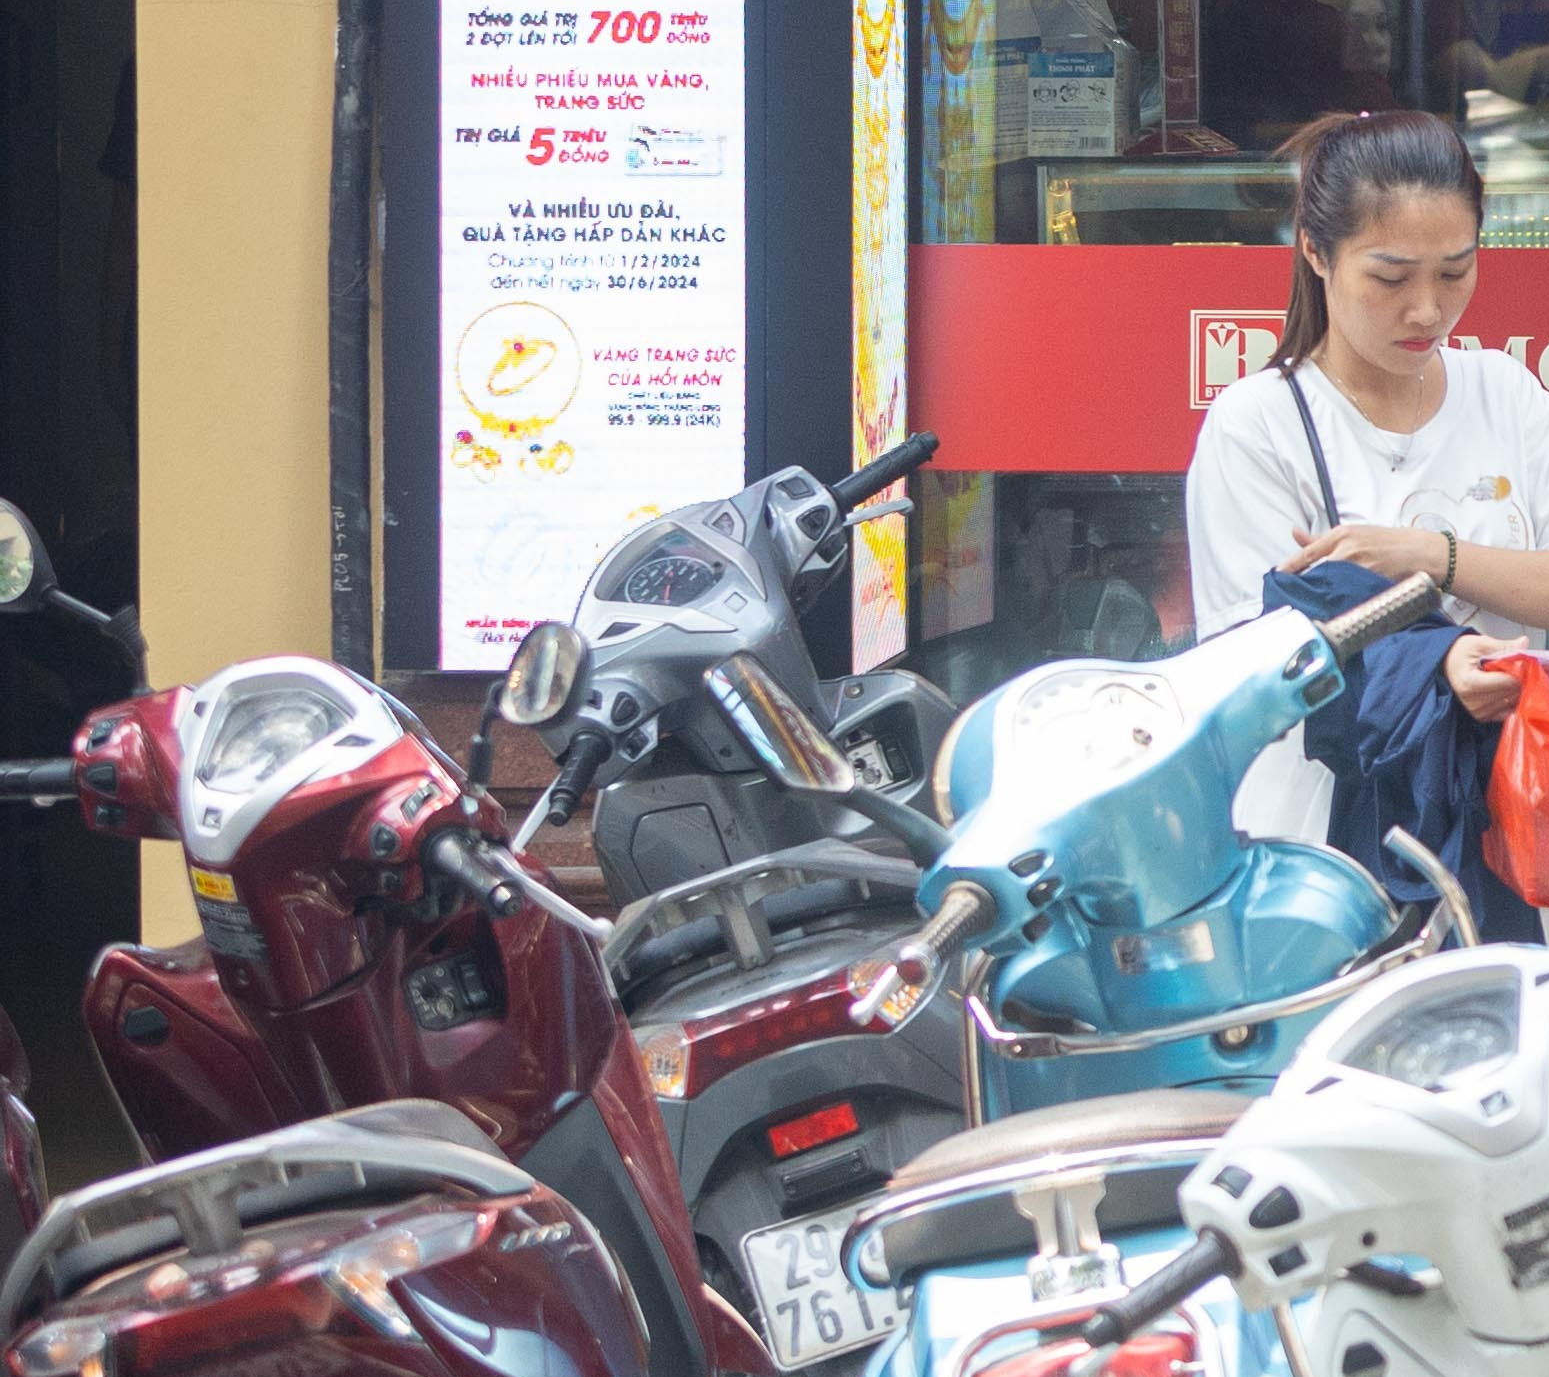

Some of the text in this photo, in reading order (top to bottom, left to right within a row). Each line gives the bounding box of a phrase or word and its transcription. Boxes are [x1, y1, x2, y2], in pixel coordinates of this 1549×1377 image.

[587, 11, 662, 45] 700
[526, 128, 556, 165] 5
[509, 200, 536, 219] VÀ
[462, 223, 505, 243] QUÀ
[513, 224, 567, 246] TẶNG
[671, 223, 726, 242] KHÁC
[621, 254, 701, 269] 1/2/2024
[607, 275, 698, 291] 30/6/2024
